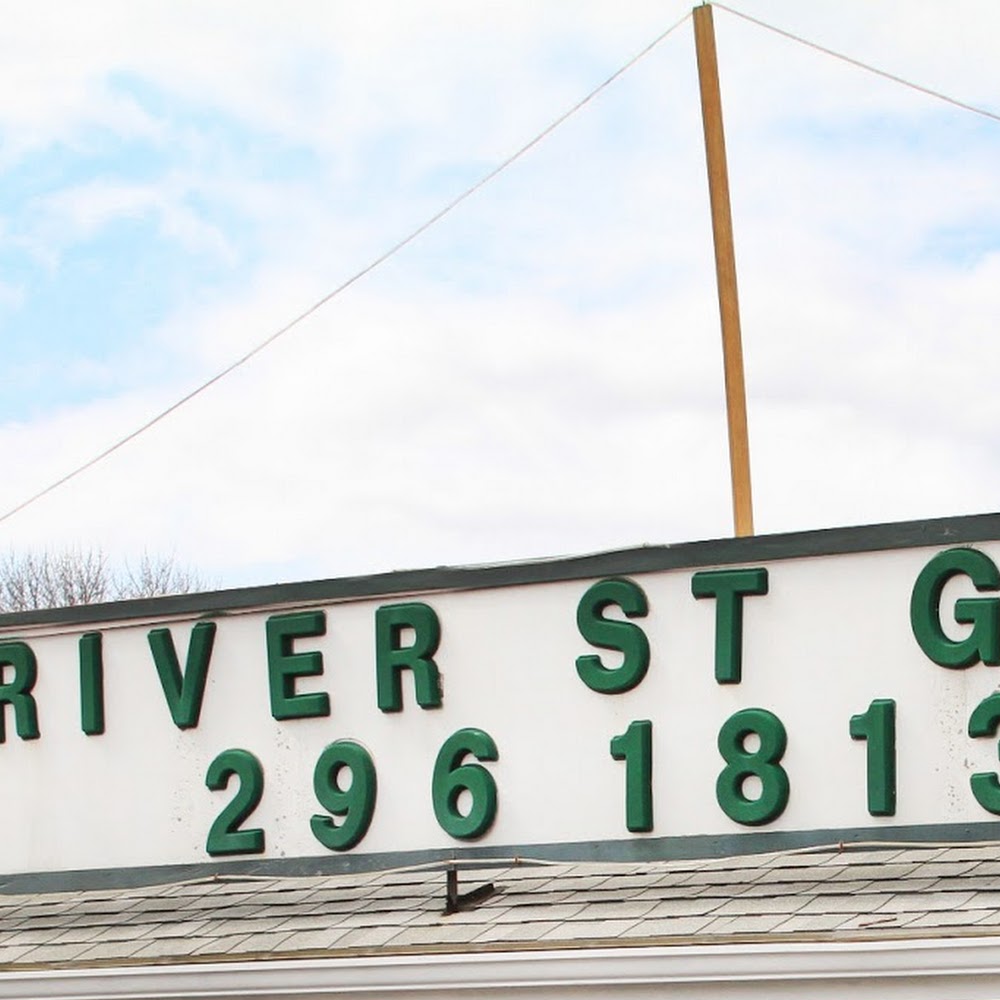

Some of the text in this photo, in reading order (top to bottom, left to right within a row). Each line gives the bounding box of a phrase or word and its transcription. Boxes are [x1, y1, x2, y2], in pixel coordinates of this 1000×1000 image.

[0, 602, 442, 742] RIVER
[575, 567, 769, 694] ST
[205, 727, 499, 856] 296
